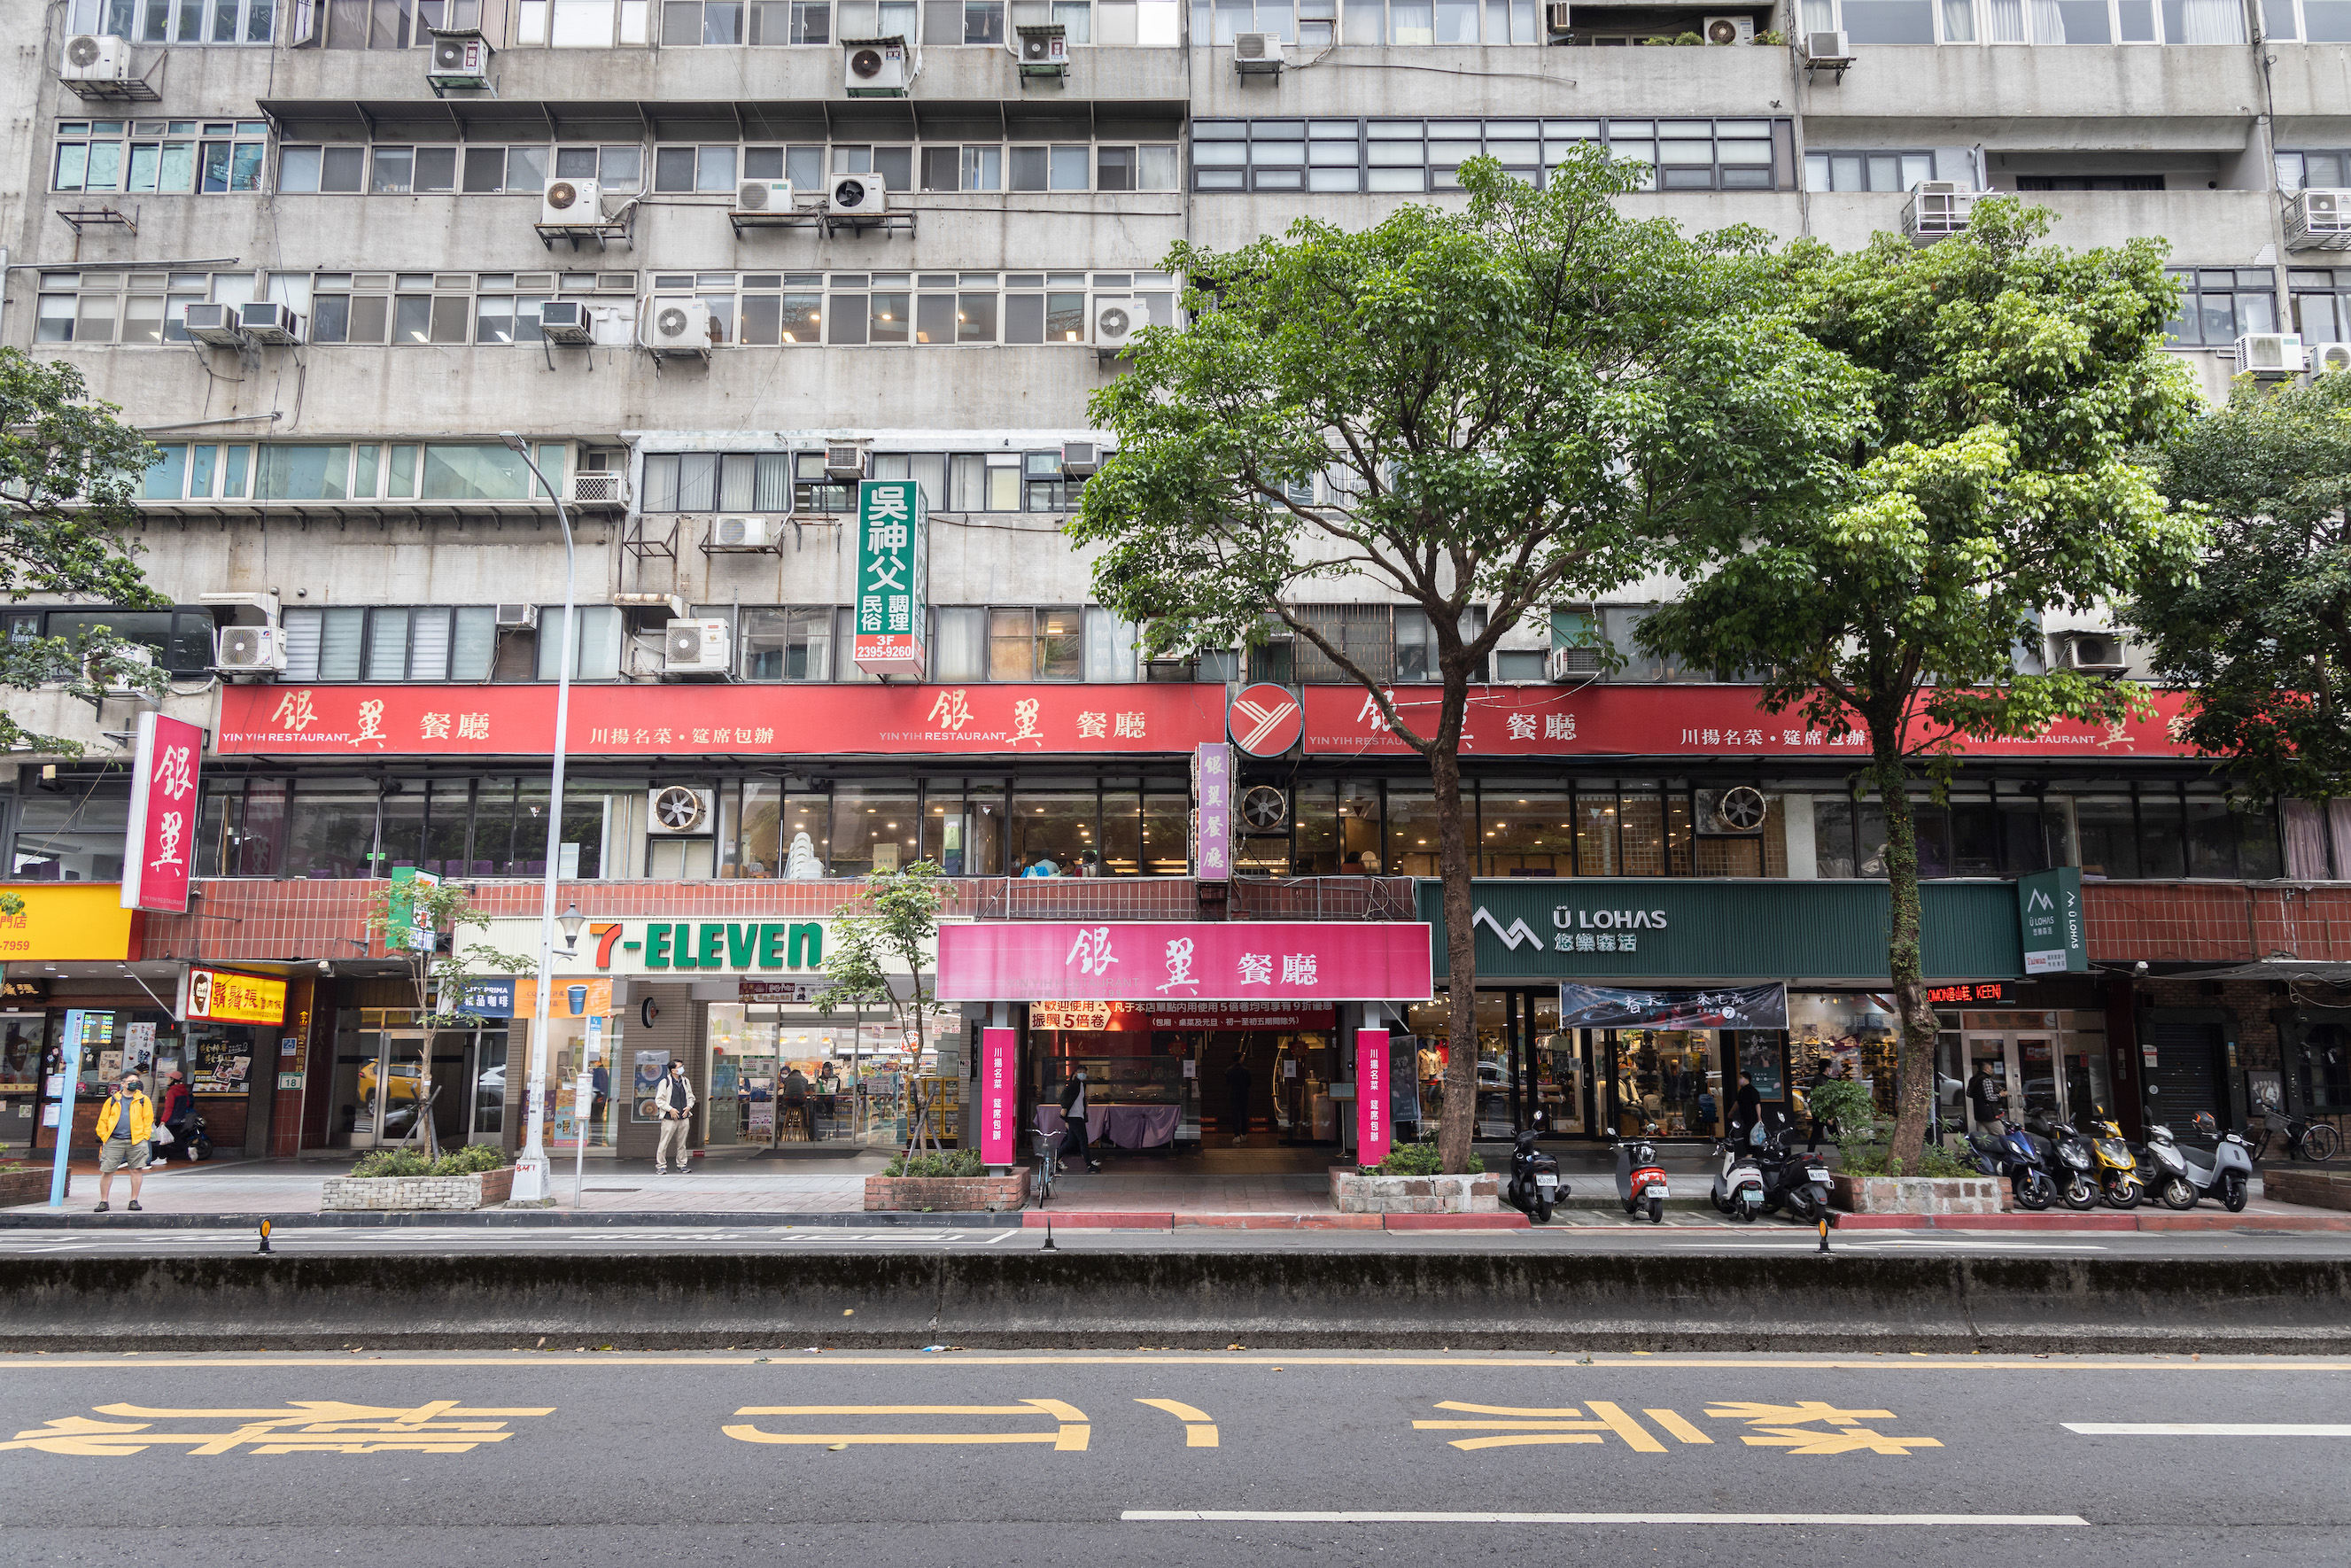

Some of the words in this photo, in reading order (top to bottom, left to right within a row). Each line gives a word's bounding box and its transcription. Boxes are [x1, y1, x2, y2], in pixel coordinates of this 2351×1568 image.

[867, 486, 908, 591] 吳神父
[861, 594, 882, 631] 民俗
[888, 594, 910, 631] 調理
[876, 635, 895, 646] 3F
[857, 646, 912, 658] 2395-9260
[419, 711, 490, 741] 餐廳
[1076, 710, 1146, 739] 餐廳
[1506, 712, 1577, 741] 餐廳
[222, 733, 244, 741] YIN
[245, 733, 267, 741] YIH
[268, 733, 350, 741] RESTAURANT
[880, 732, 899, 741] YIN
[902, 732, 922, 741] YIH
[925, 732, 1007, 741] RESTAURANT
[1309, 736, 1329, 745] YIN
[1332, 736, 1353, 745] YIH
[158, 897, 185, 906] RESTAURANT
[1579, 910, 1668, 929] LOHAS
[1554, 933, 1638, 952] 悠樂森活
[1237, 952, 1319, 986] 餐廳
[2027, 957, 2046, 966] Taiwan
[1008, 978, 1028, 988] YIN
[1032, 978, 1052, 988] YIH
[1056, 977, 1140, 988] RESTAURANT
[1044, 1000, 1094, 1012] 歡迎使用
[1625, 994, 1664, 1014] 春天
[993, 1047, 1003, 1089] 川揚名菜
[1369, 1048, 1379, 1091] 川揚名菜
[285, 1078, 297, 1087] 18
[992, 1098, 1002, 1141] 筵席包辦
[1369, 1099, 1379, 1142] 筵席包辦
